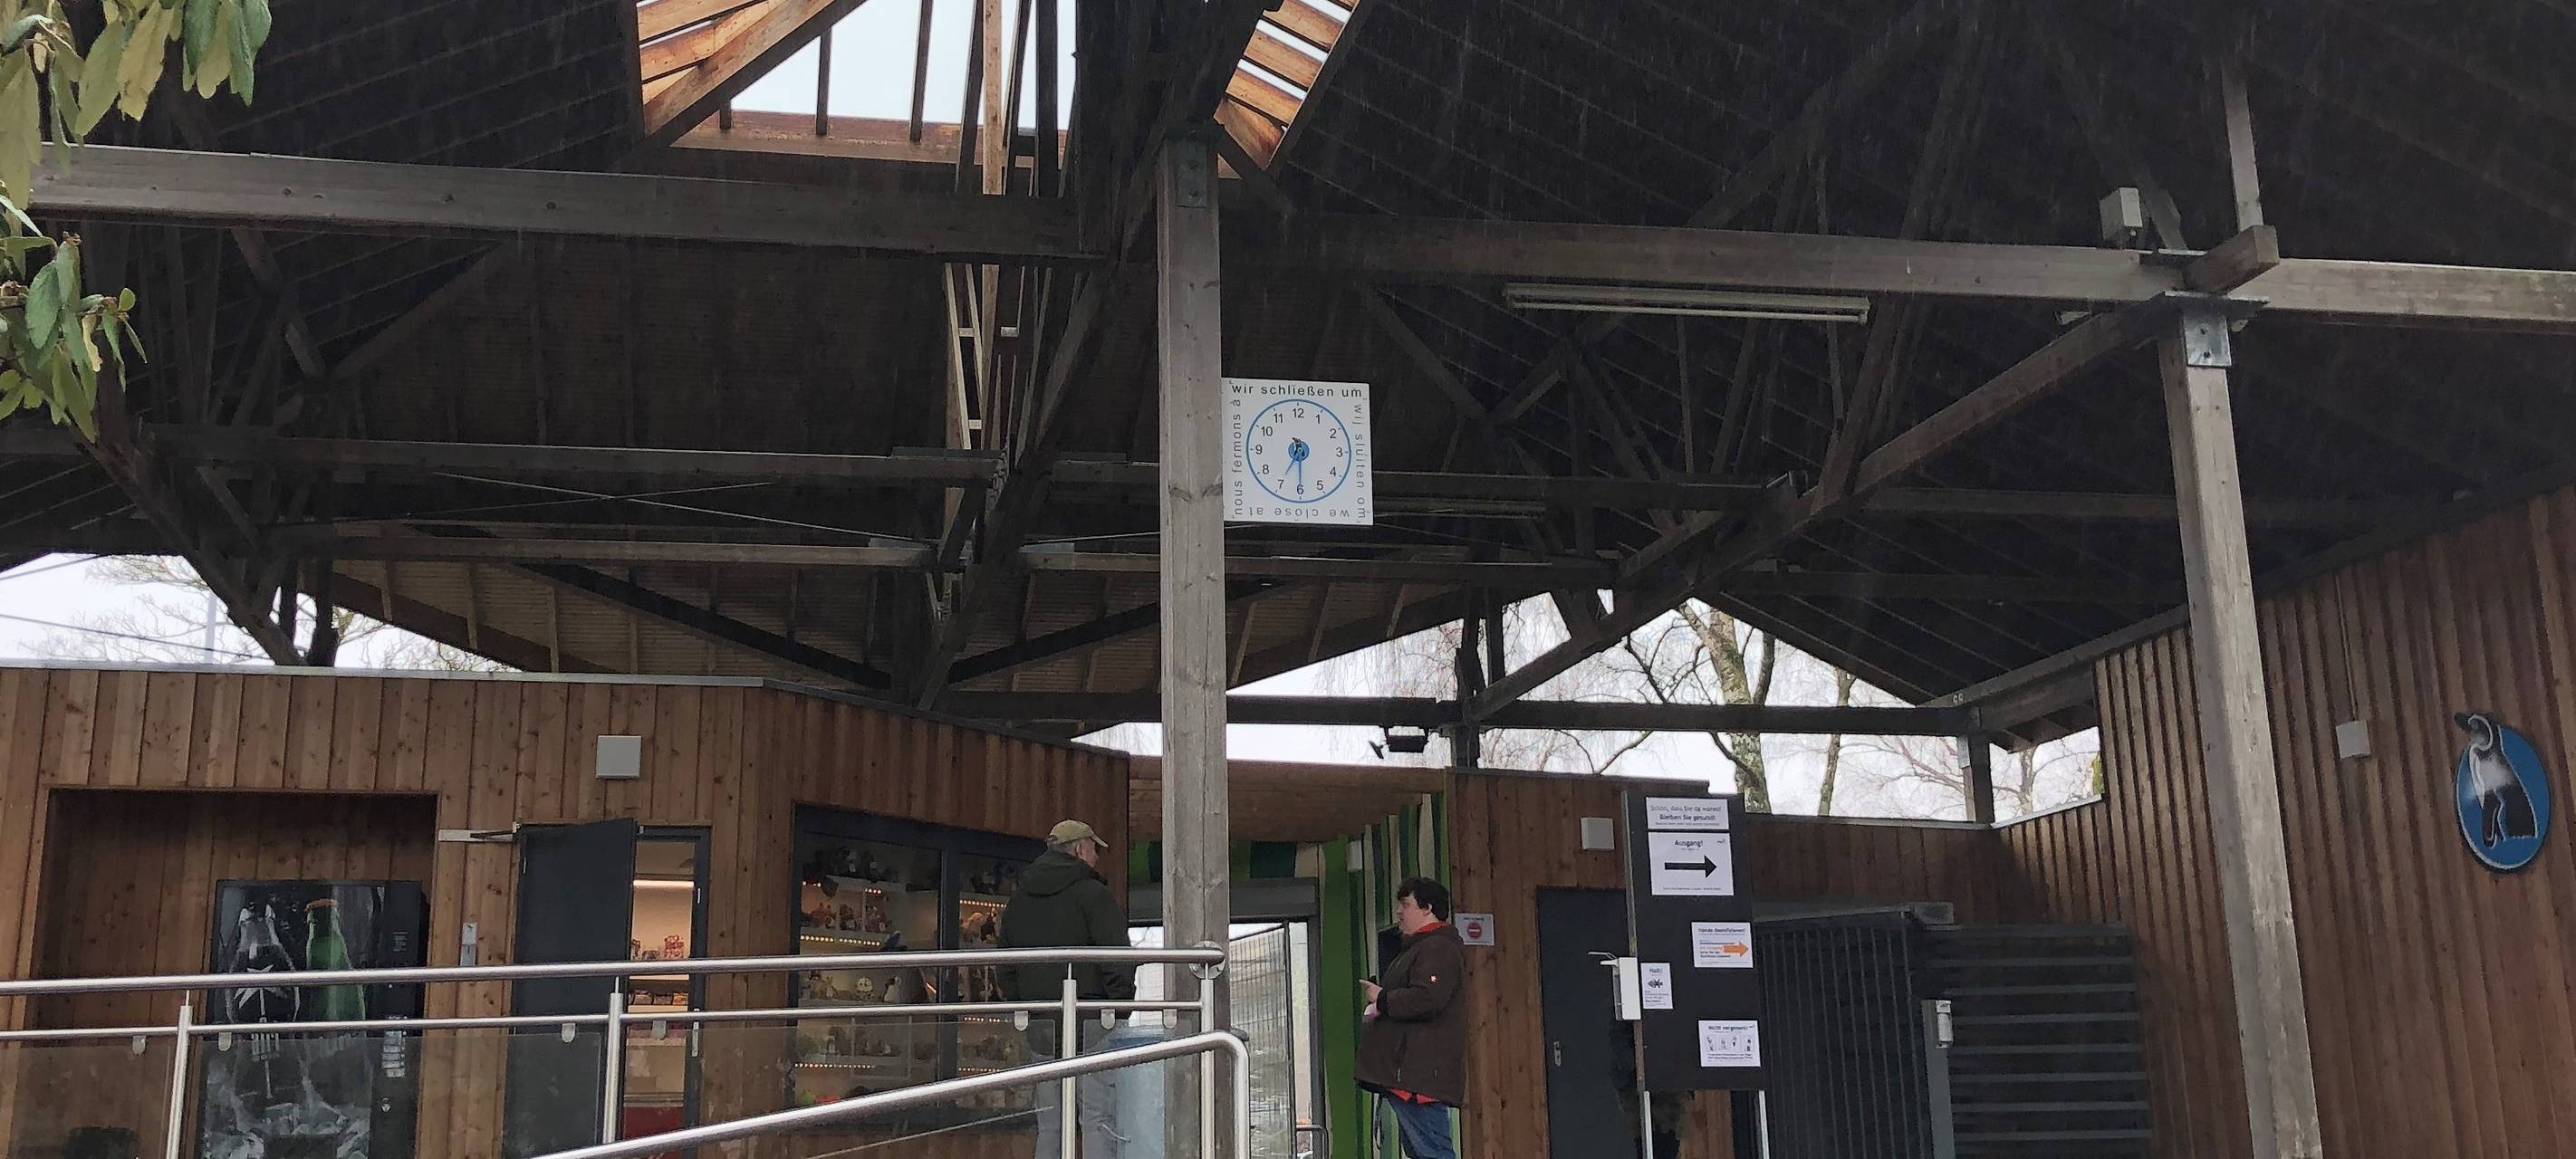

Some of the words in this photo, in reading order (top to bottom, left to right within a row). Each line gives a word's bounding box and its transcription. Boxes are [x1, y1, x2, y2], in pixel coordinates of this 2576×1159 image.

[1231, 384, 1254, 394] wir
[1261, 384, 1334, 397] schließen
[1341, 388, 1362, 398] um
[1292, 407, 1304, 418] 12
[1352, 404, 1362, 425] wij
[1274, 413, 1283, 424] 11
[1315, 414, 1321, 425] 1
[1261, 426, 1274, 436] 10
[1330, 428, 1337, 438] 2
[1232, 414, 1242, 473] fermons
[1255, 445, 1263, 455] 9
[1336, 447, 1343, 457] 3
[1354, 434, 1366, 488] sluiten
[1262, 465, 1270, 474] 8
[1330, 466, 1337, 476] 4
[1277, 479, 1284, 489] 7
[1296, 484, 1304, 494] 6
[1316, 480, 1323, 490] 5
[1234, 481, 1243, 515] nous
[1249, 507, 1264, 515] at
[1274, 508, 1319, 517] close
[1329, 509, 1350, 517] we
[1358, 497, 1366, 519] om
[1675, 839, 1703, 848] Ausgang!
